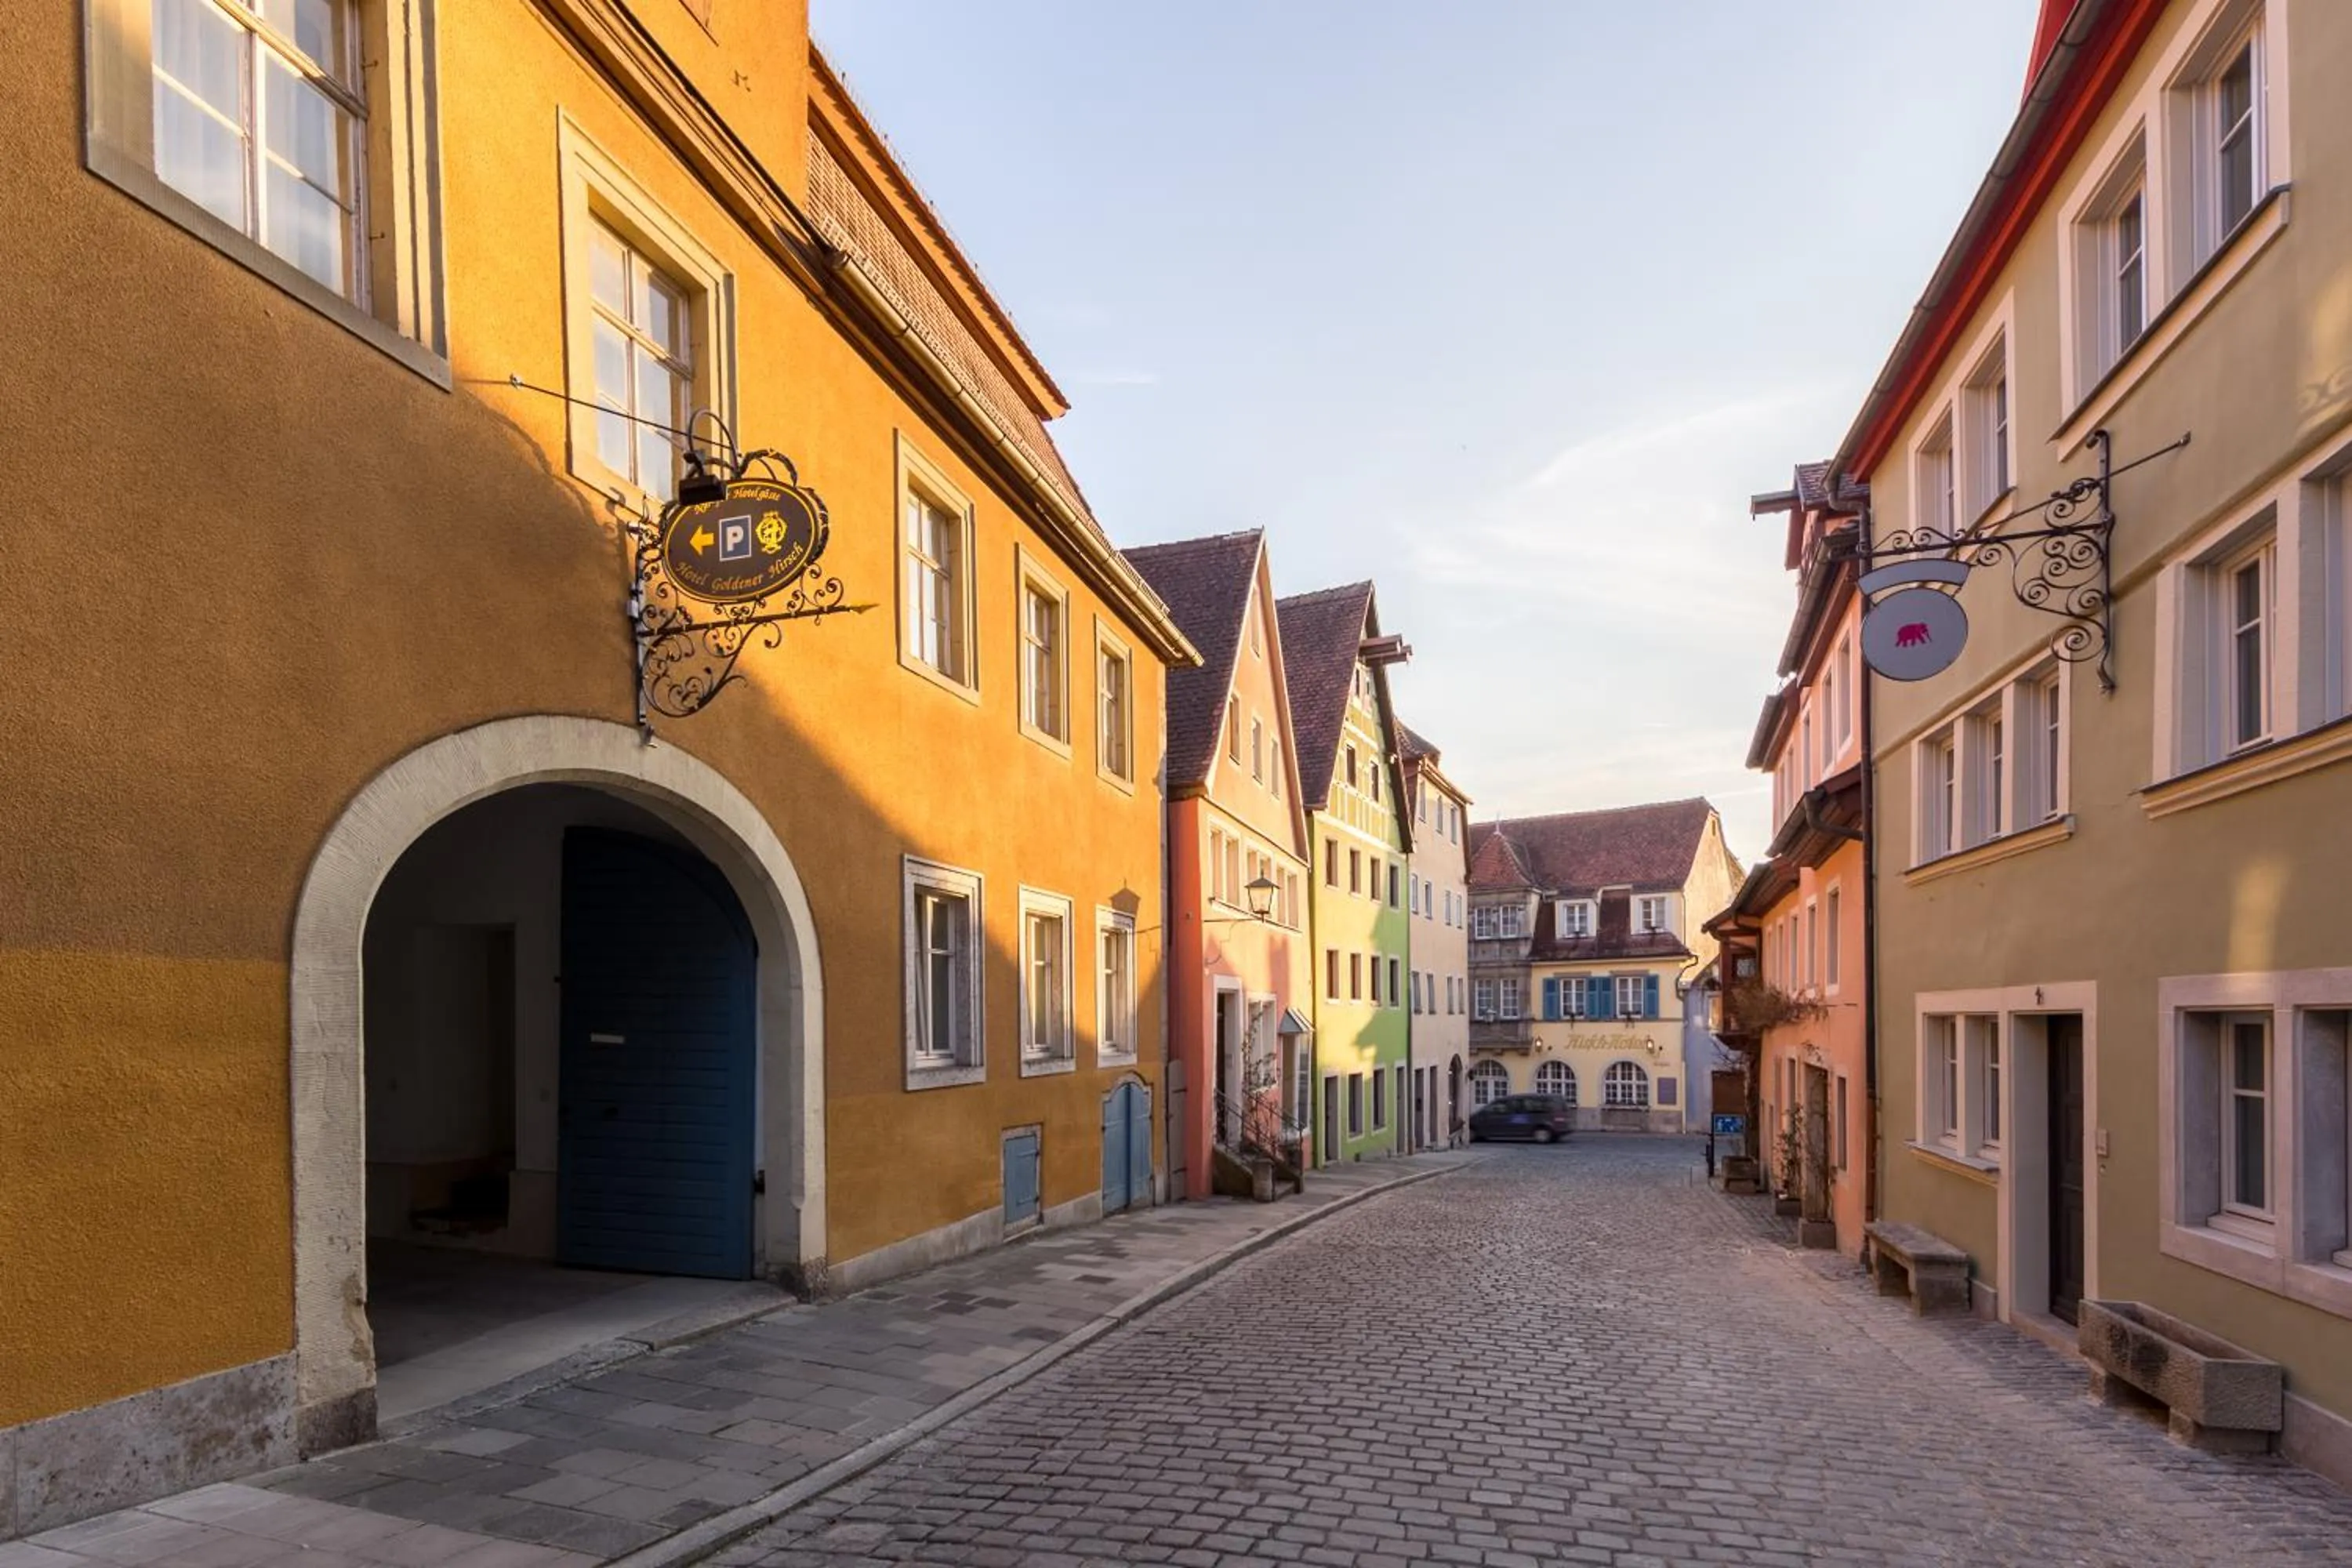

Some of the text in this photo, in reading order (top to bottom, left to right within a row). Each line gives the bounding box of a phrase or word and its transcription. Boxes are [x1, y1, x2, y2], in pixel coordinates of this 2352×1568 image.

[726, 525, 744, 552] P
[676, 541, 804, 593] Hotel Goldener Hirsch
